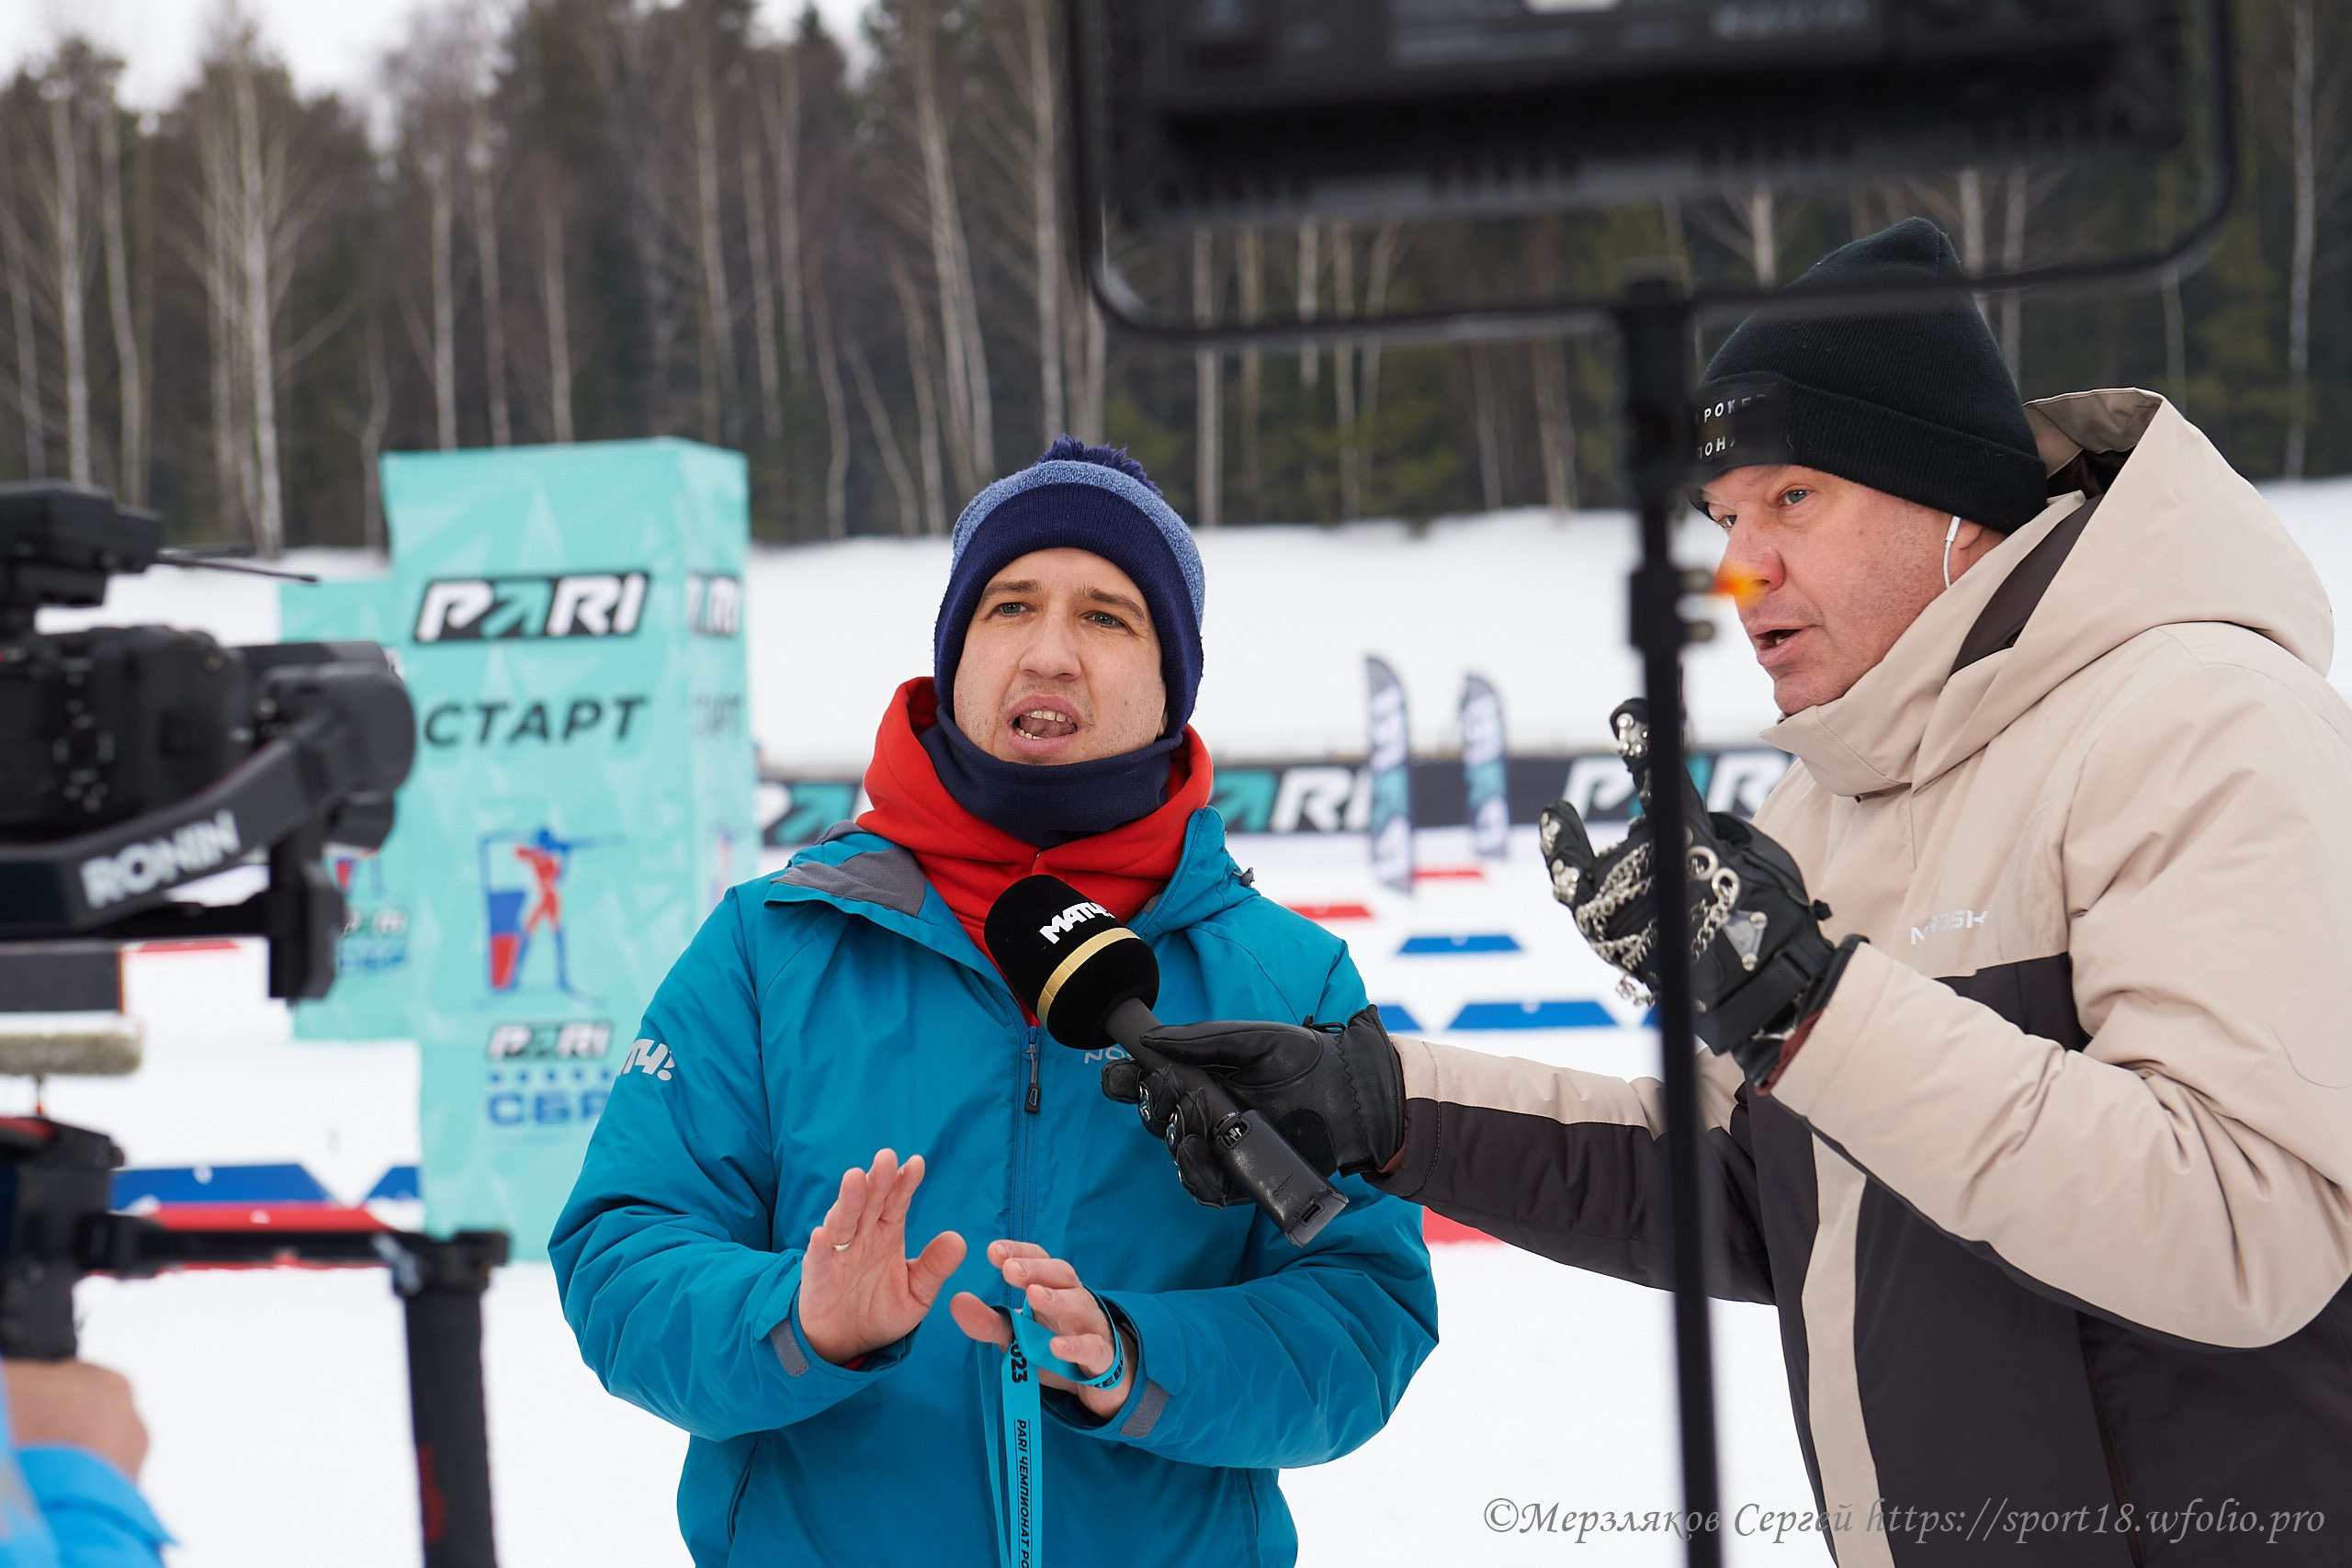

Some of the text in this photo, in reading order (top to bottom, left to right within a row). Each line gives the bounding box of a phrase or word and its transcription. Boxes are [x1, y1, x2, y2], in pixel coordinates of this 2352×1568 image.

[414, 570, 648, 644] PARI
[423, 695, 650, 749] СТАРТ
[1213, 766, 1374, 833] ARI
[81, 808, 241, 909] RONIN
[1011, 1336, 1028, 1383] 023
[1017, 1419, 1028, 1452] PARI
[1019, 1456, 1029, 1548] ЧЕМПИОНАТ
